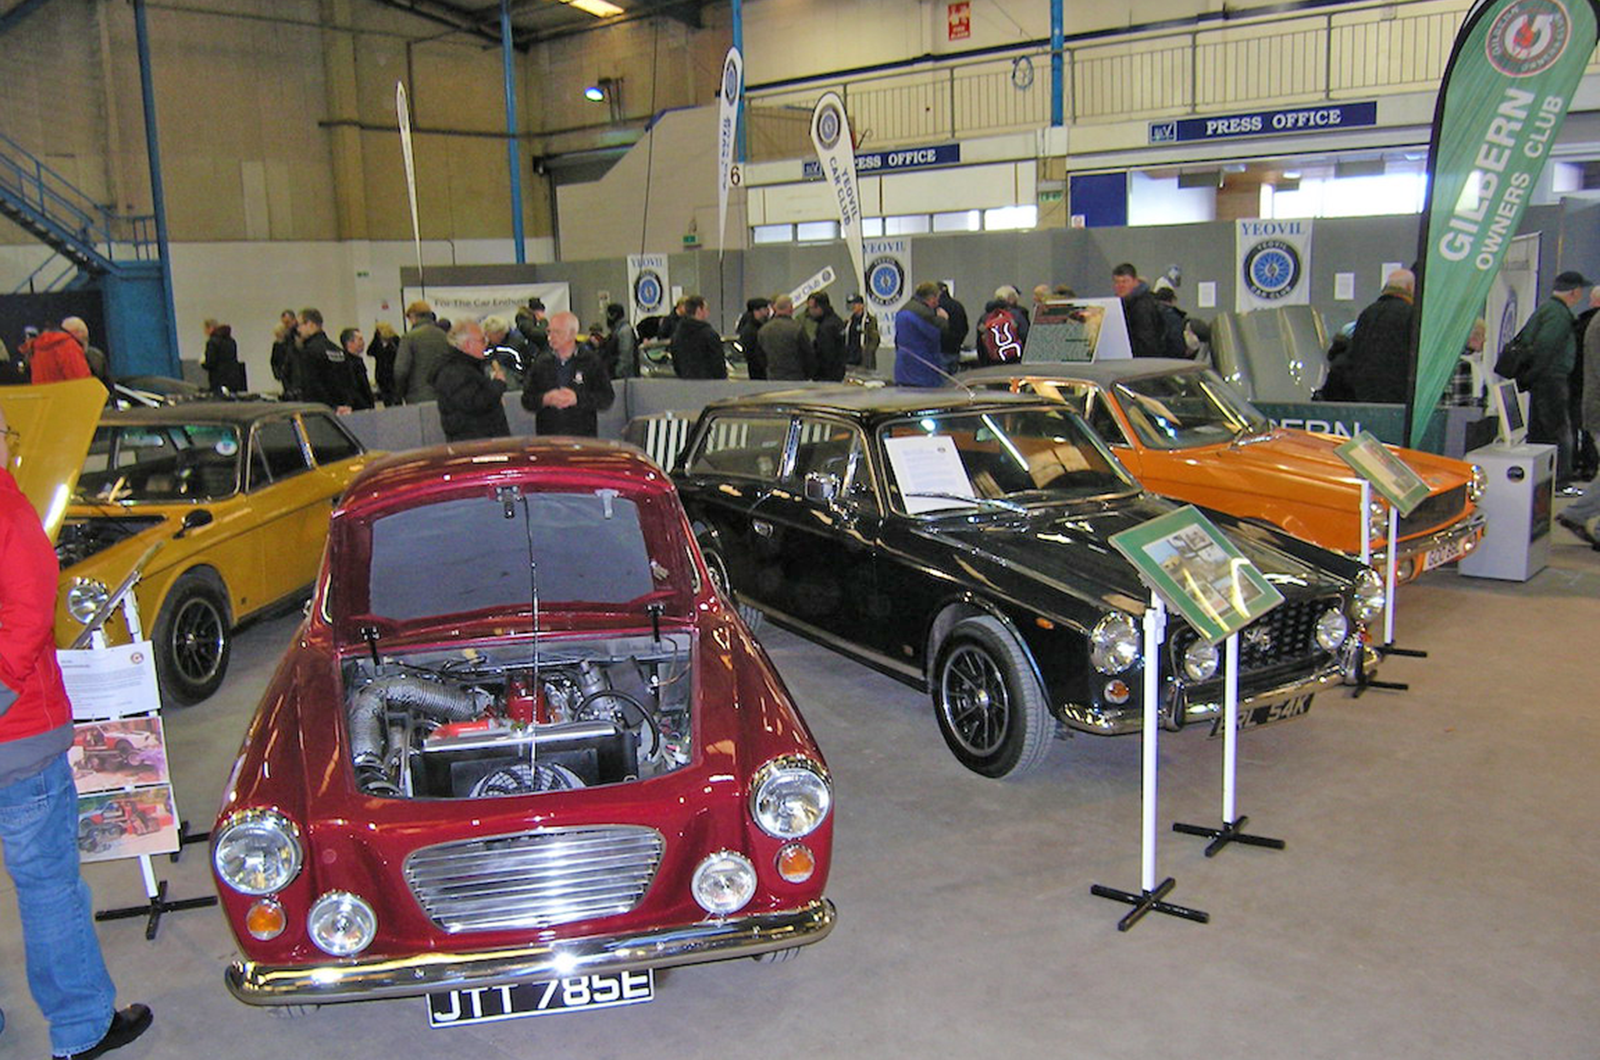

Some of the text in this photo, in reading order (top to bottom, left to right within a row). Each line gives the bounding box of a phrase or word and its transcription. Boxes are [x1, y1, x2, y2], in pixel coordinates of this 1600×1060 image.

[1206, 109, 1341, 136] PRESS OFFICE
[731, 165, 741, 186] 6
[888, 149, 936, 167] OFFICE
[1439, 87, 1536, 261] GILBERN
[1476, 95, 1563, 270] OWNERS CLUB
[829, 156, 851, 226] CAR CLUB
[842, 167, 858, 222] YEOVIL
[1242, 222, 1305, 236] YEOVIL
[433, 970, 650, 1022] JTT 785E
